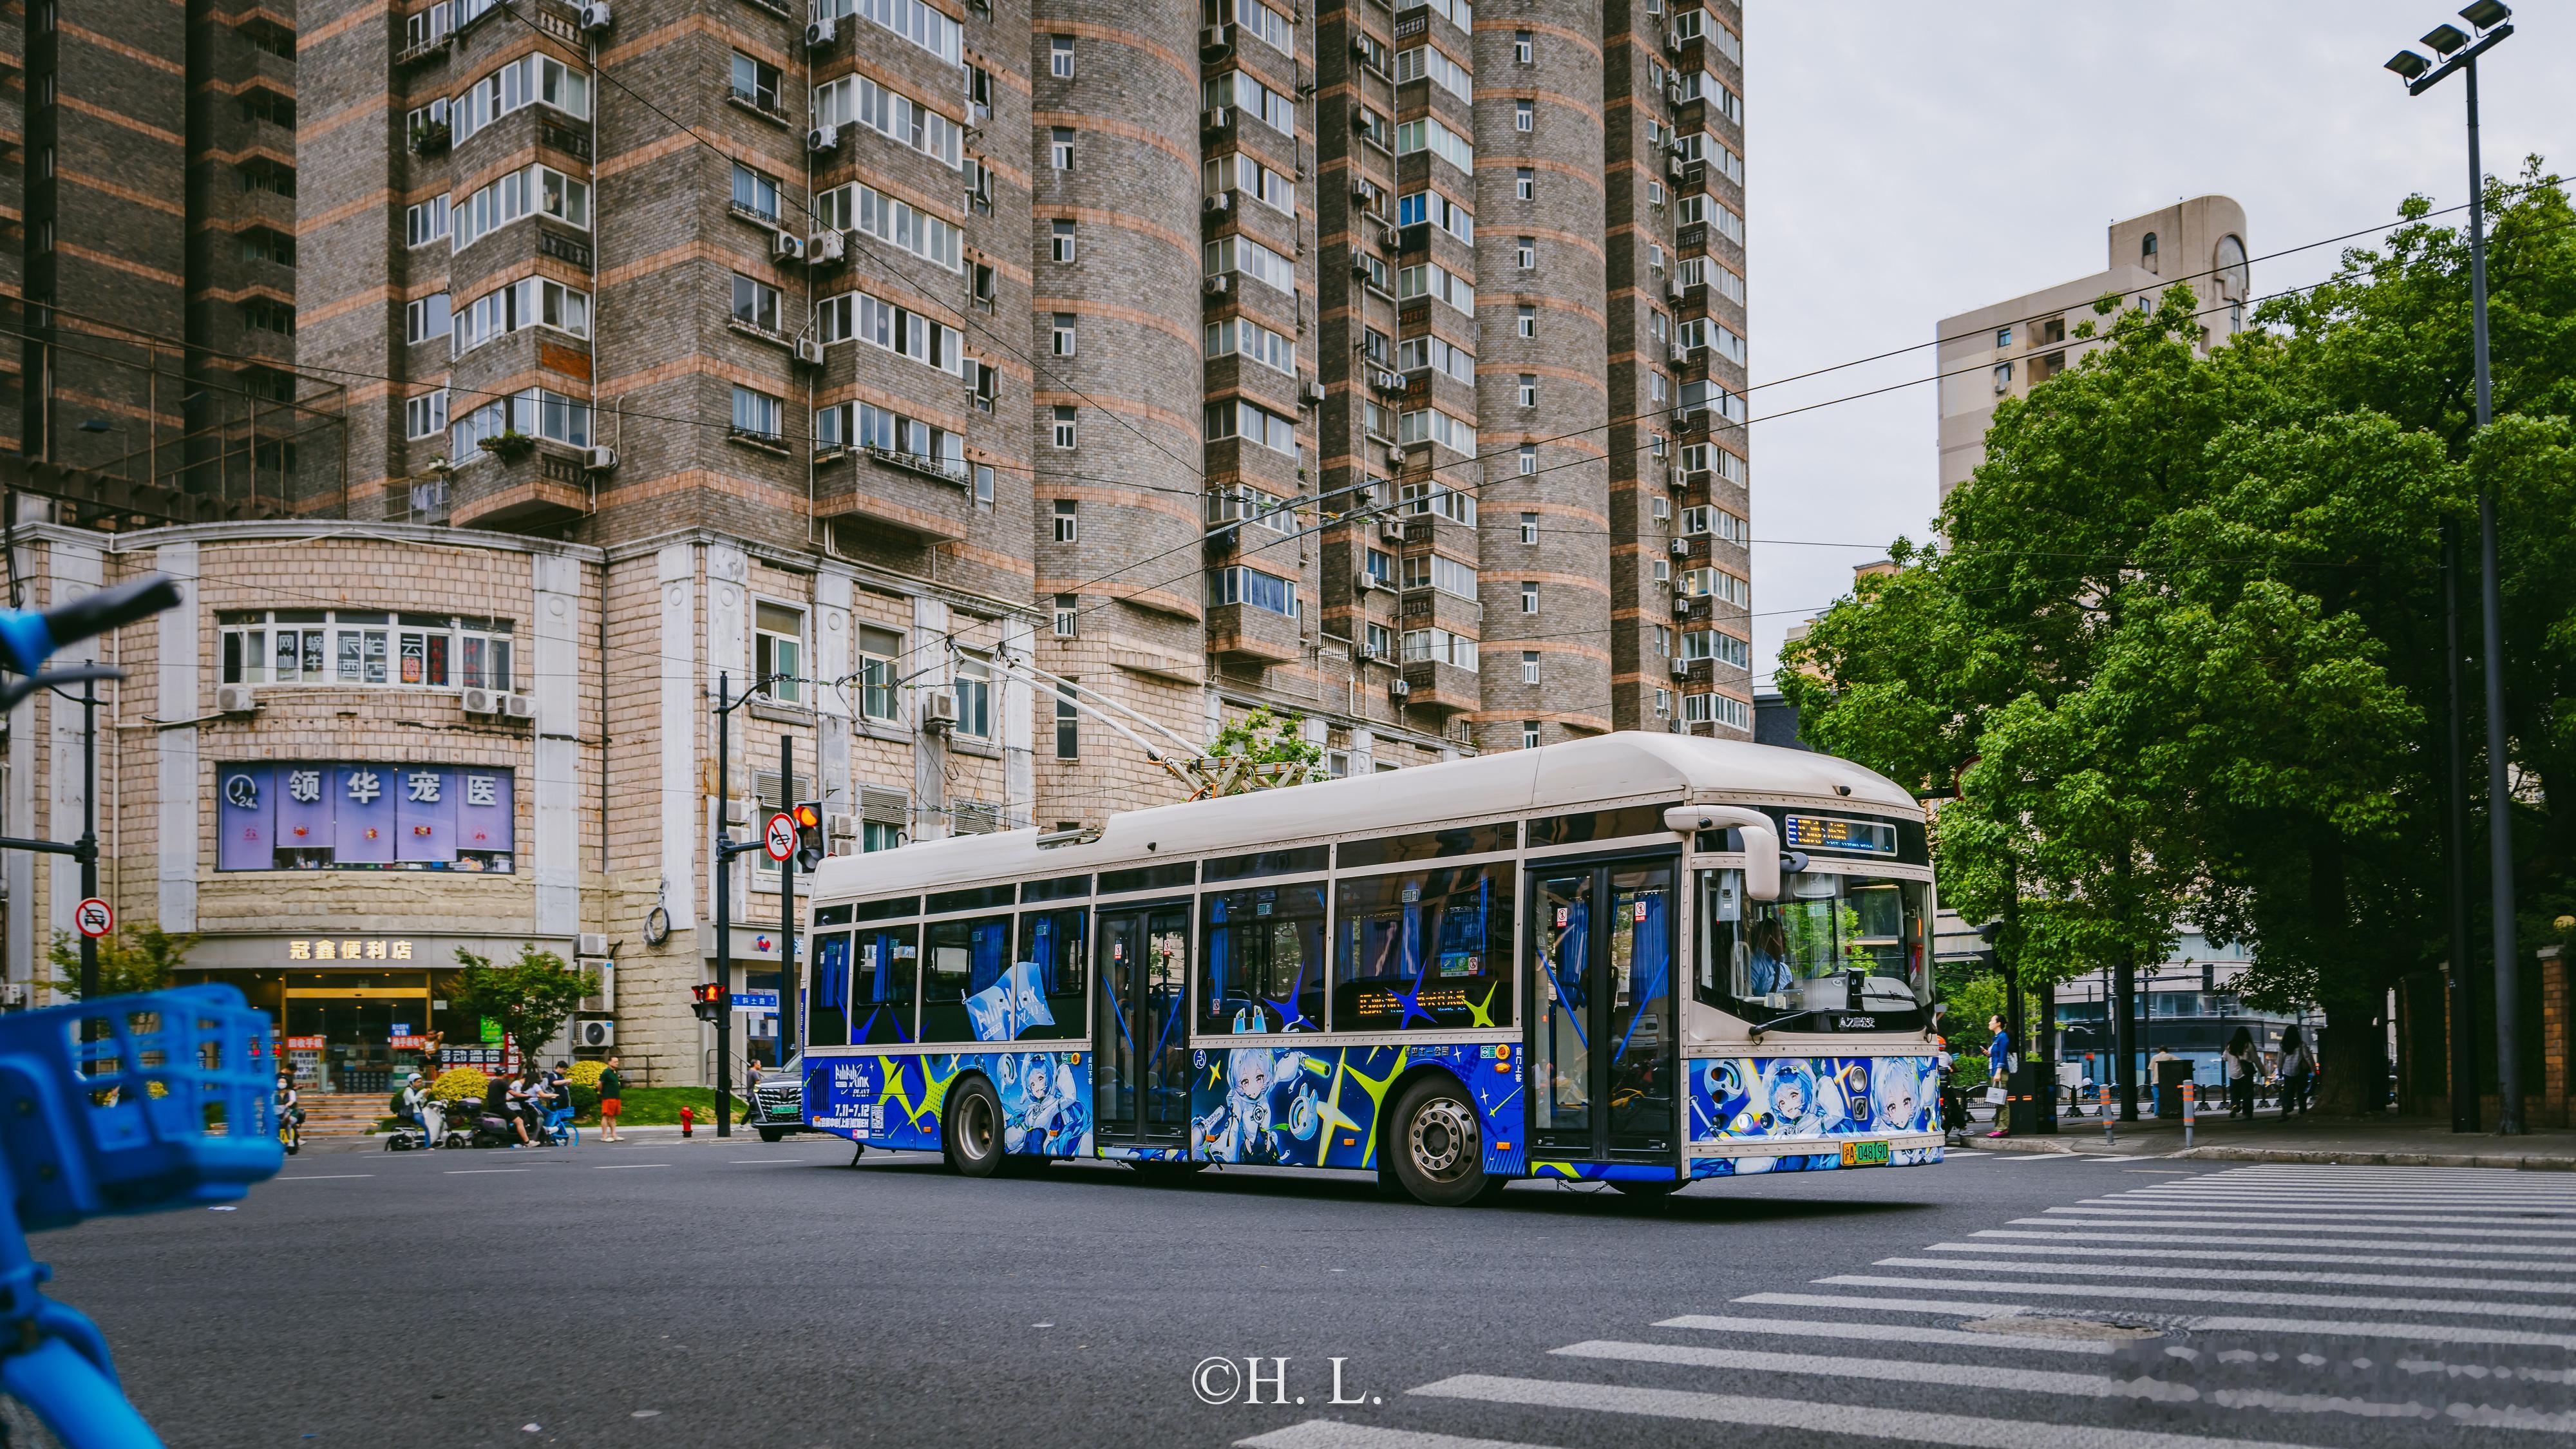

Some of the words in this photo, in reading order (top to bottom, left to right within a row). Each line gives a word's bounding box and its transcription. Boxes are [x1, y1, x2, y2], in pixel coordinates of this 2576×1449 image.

[289, 770, 497, 806] 领华宠医
[289, 939, 412, 960] 冠鑫便利店
[288, 1037, 323, 1048] 回收手机
[835, 1104, 870, 1117] 7.11-7.12
